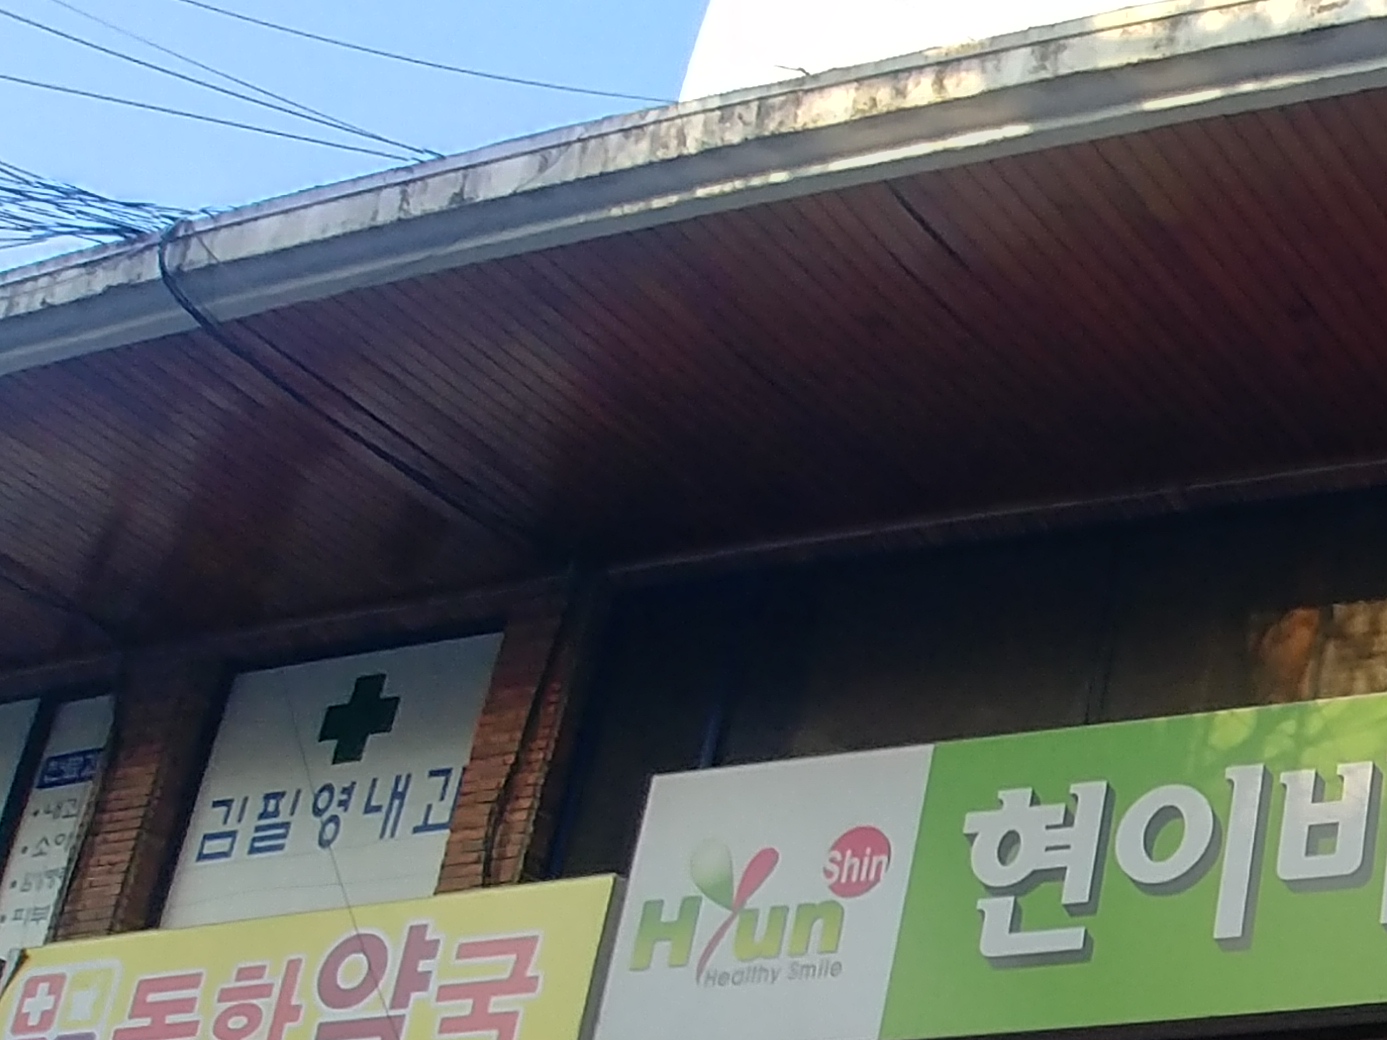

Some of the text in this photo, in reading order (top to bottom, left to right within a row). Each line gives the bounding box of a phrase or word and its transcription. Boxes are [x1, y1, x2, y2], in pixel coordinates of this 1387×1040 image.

[822, 848, 889, 886] Shin
[704, 958, 842, 988] Healthy Smile
